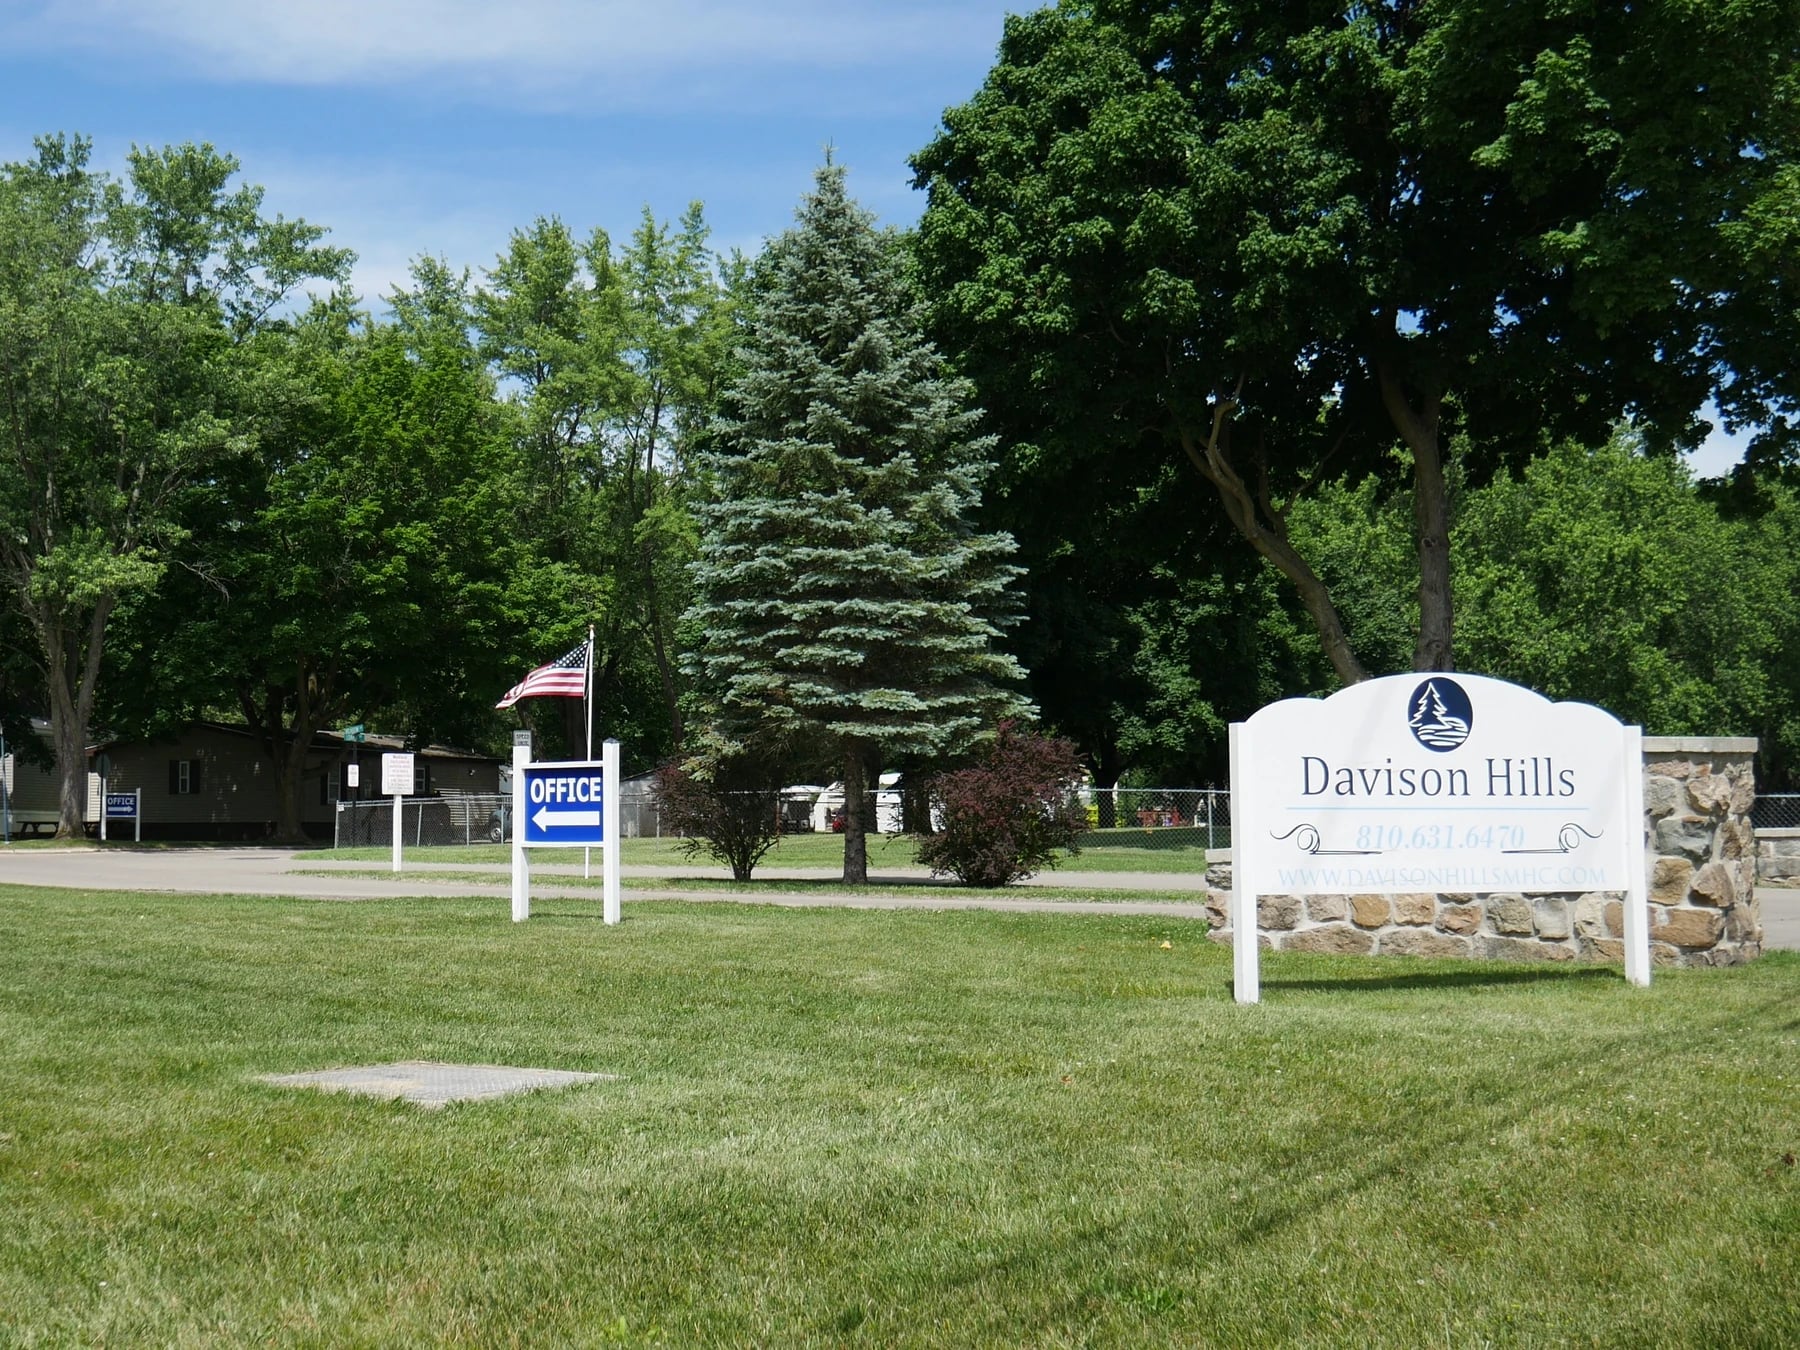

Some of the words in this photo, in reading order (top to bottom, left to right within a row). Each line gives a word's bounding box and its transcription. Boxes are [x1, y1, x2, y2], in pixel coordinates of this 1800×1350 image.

[1301, 756, 1470, 796] Davison
[1486, 757, 1575, 797] Hills
[107, 797, 135, 805] OFFICE
[530, 777, 601, 803] OFFICE
[1356, 825, 1525, 849] 810.631.6470
[1277, 866, 1606, 888] WWW.DAVISONHILLSMHC.COM
